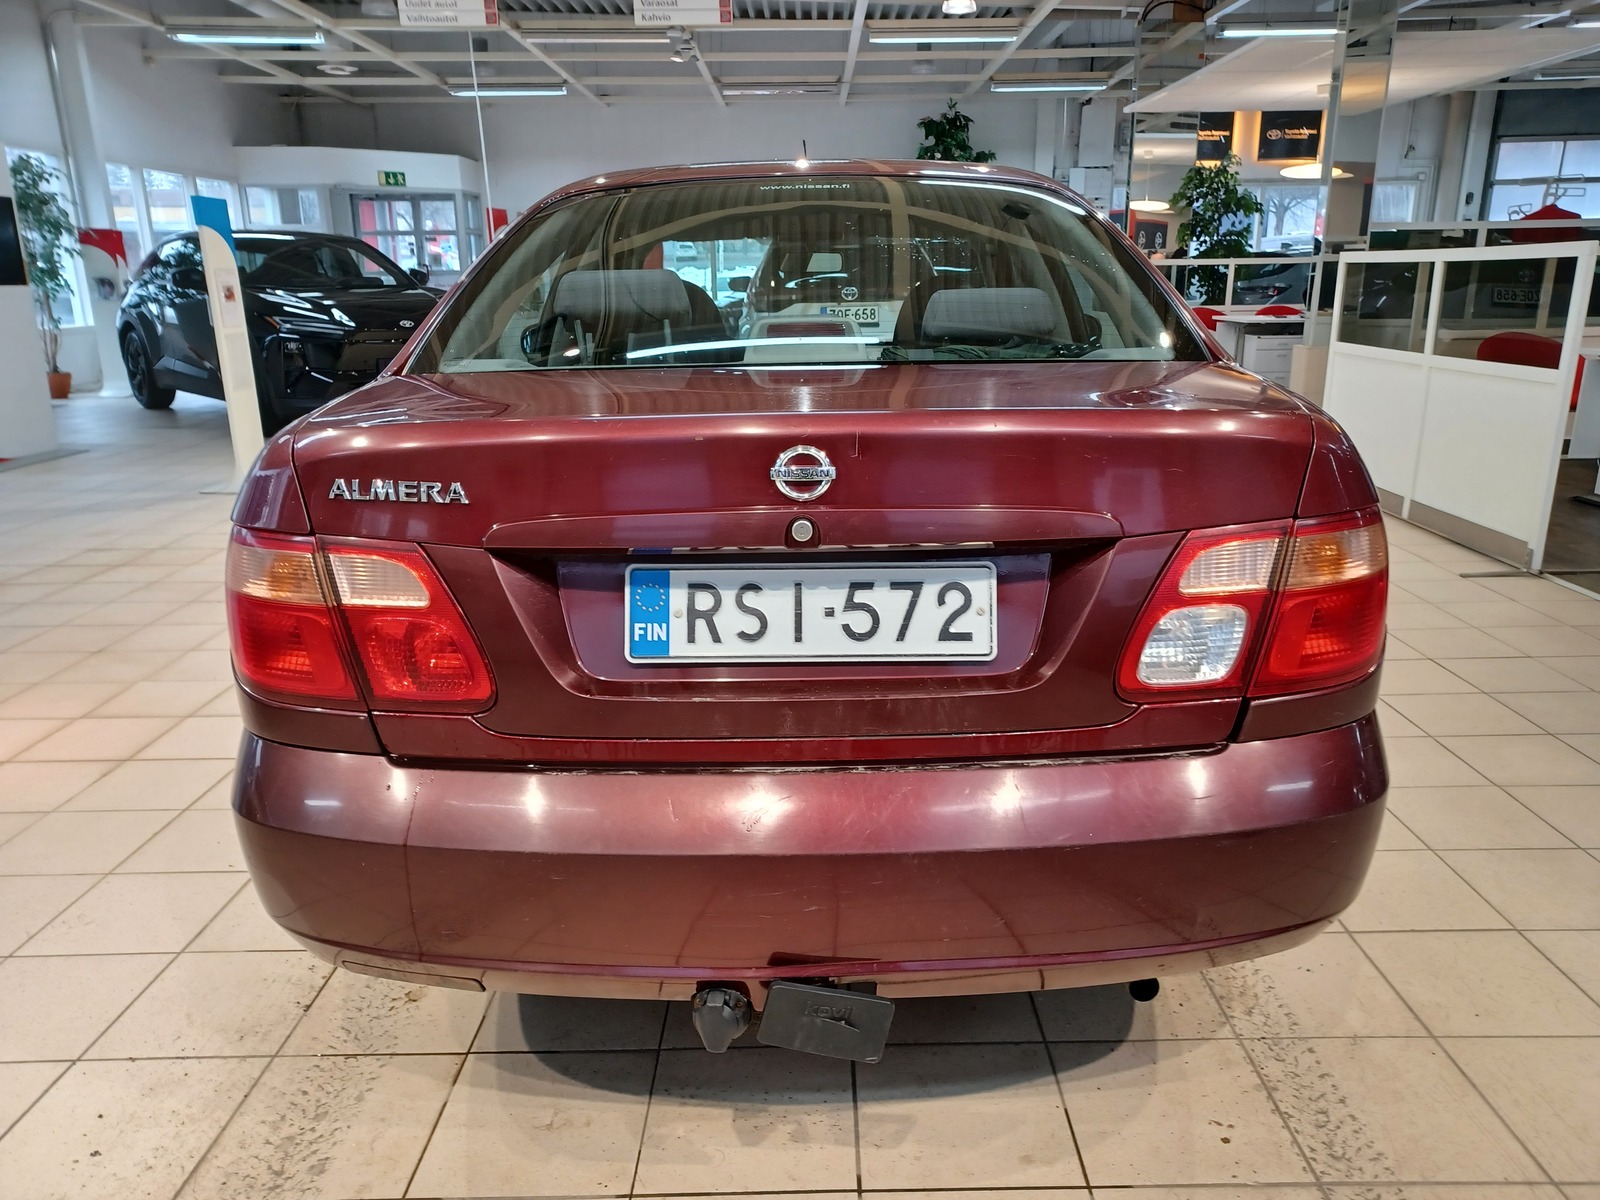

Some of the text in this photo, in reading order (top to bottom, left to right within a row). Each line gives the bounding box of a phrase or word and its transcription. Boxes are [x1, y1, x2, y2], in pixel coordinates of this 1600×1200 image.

[406, 14, 459, 23] Vaihtoautot
[641, 12, 672, 21] Kahvio
[776, 468, 830, 479] NISSAN
[328, 478, 470, 504] ALMERA
[686, 581, 973, 643] RSI-572
[633, 622, 668, 641] FIN
